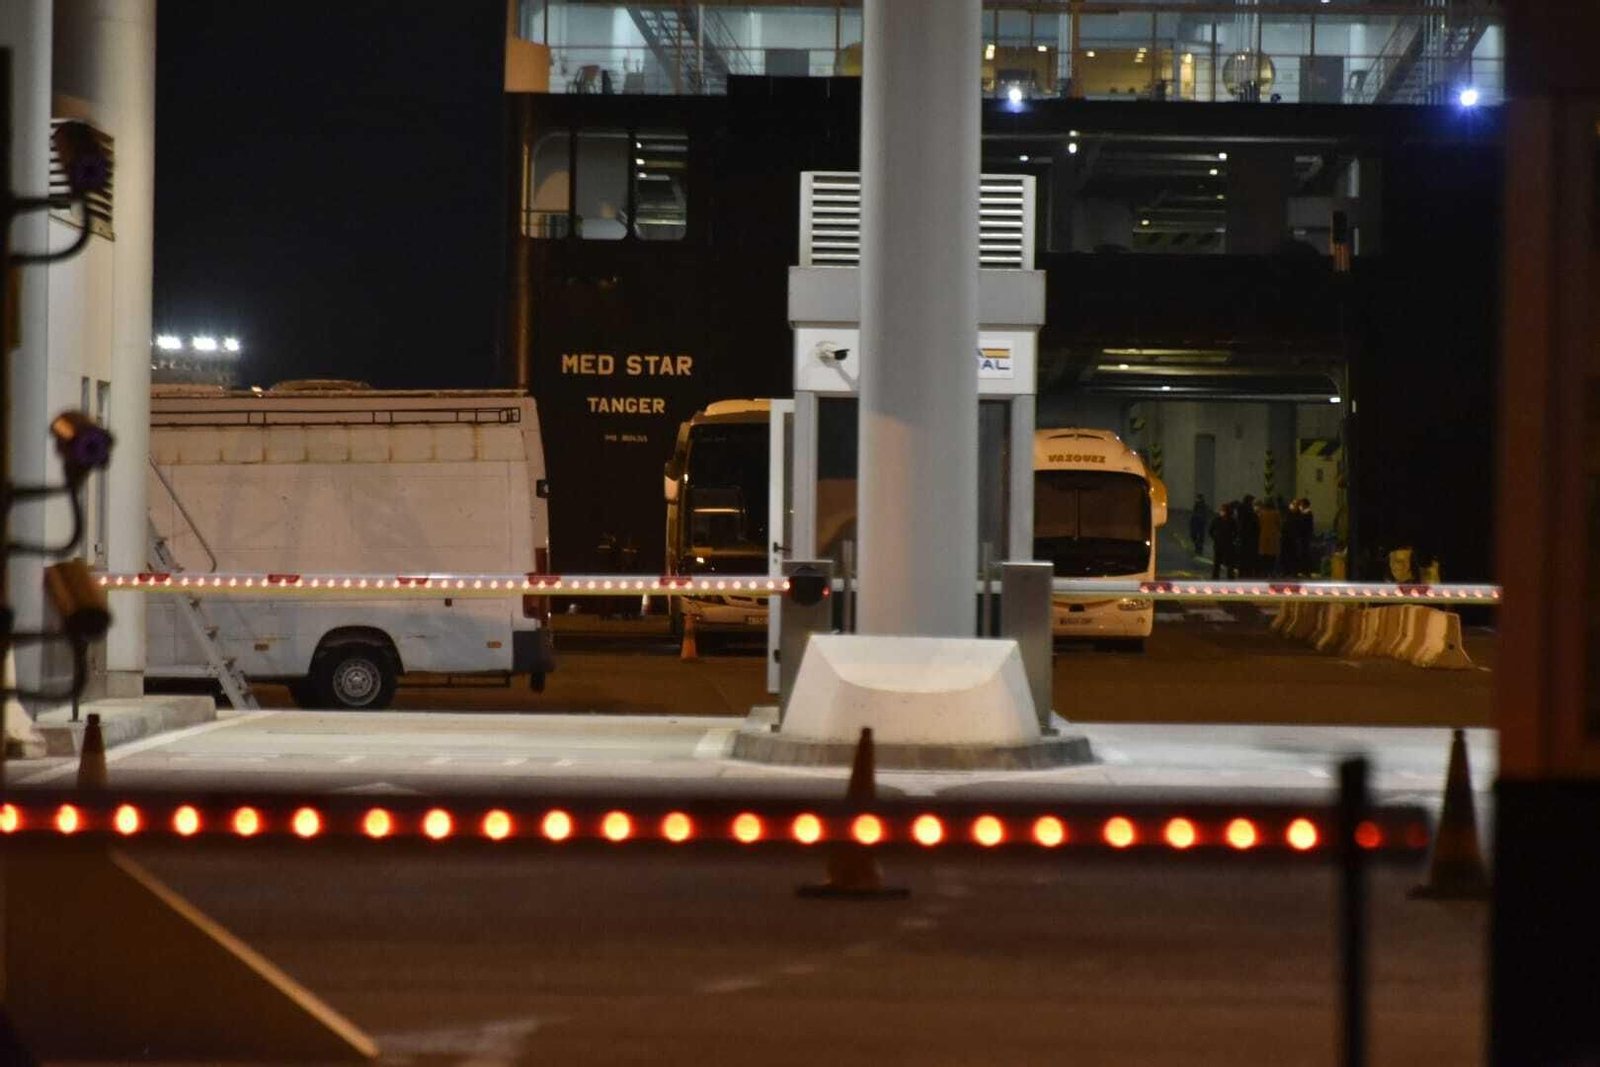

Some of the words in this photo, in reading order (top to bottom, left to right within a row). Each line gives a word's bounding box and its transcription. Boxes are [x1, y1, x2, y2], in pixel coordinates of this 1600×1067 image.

[561, 354, 615, 375] MED
[626, 355, 693, 376] STAR
[587, 397, 665, 414] TANGER
